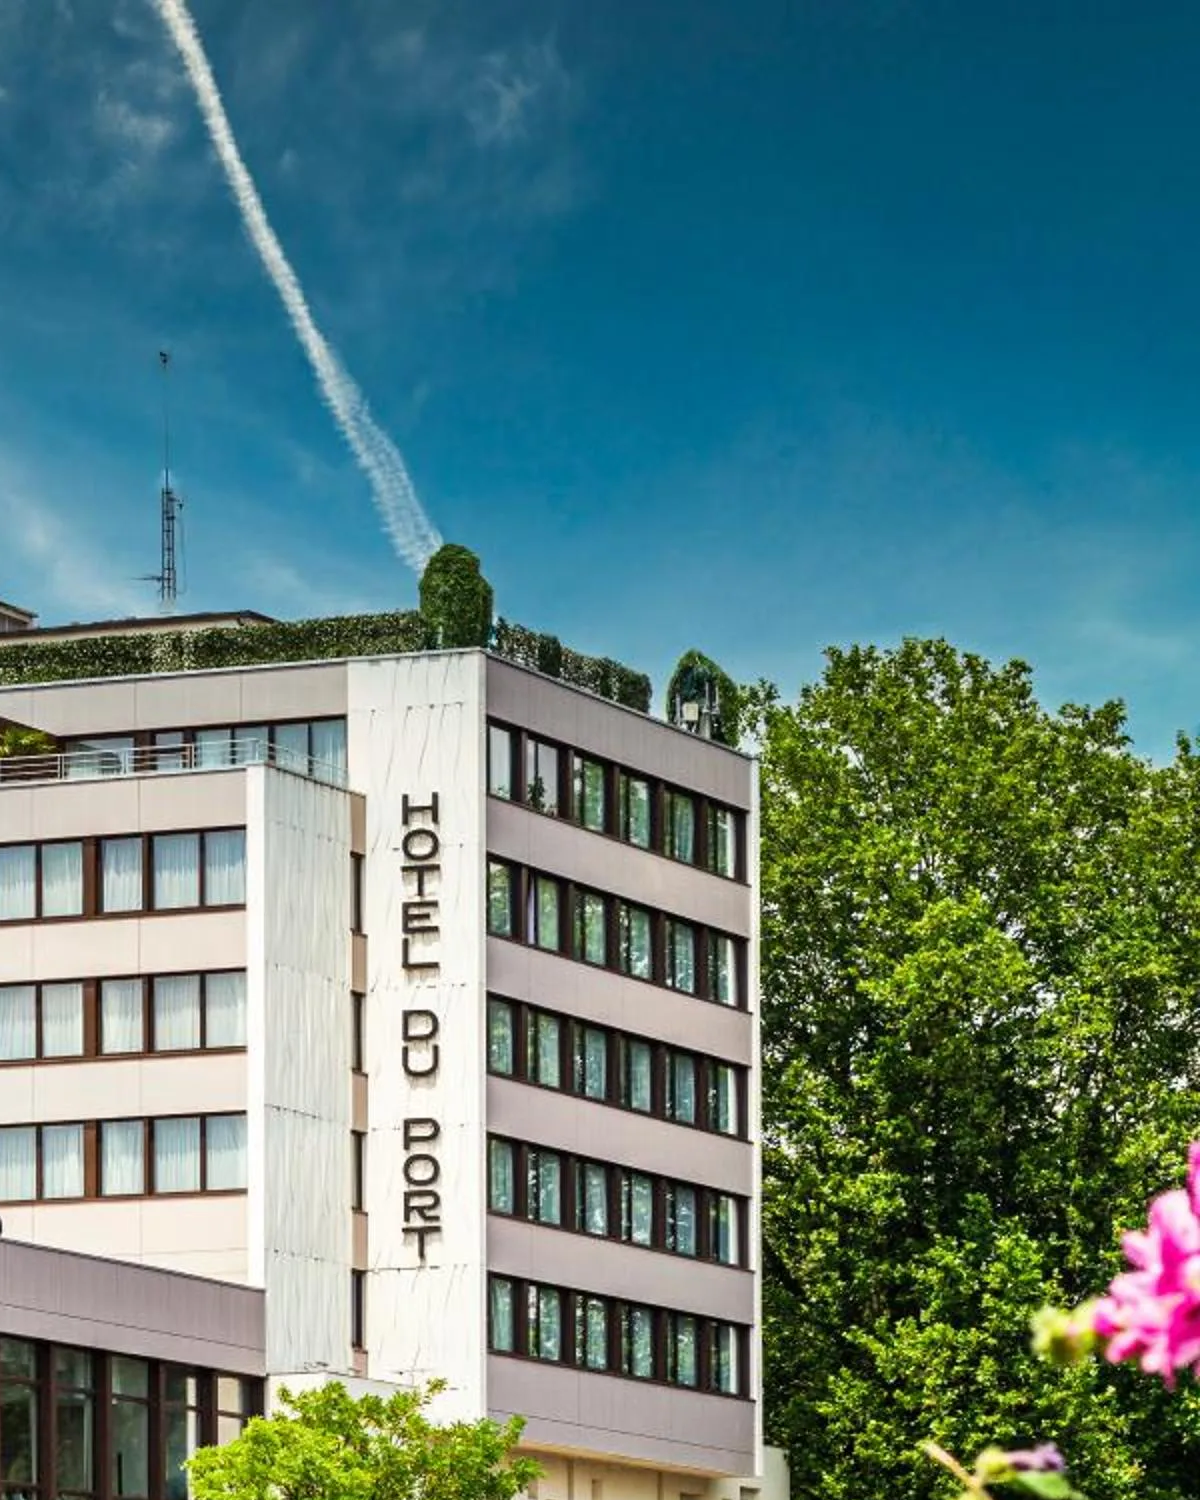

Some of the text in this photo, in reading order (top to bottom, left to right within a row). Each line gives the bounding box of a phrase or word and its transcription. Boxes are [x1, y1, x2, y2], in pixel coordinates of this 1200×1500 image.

[401, 791, 442, 1261] HOTEL DU PORT
